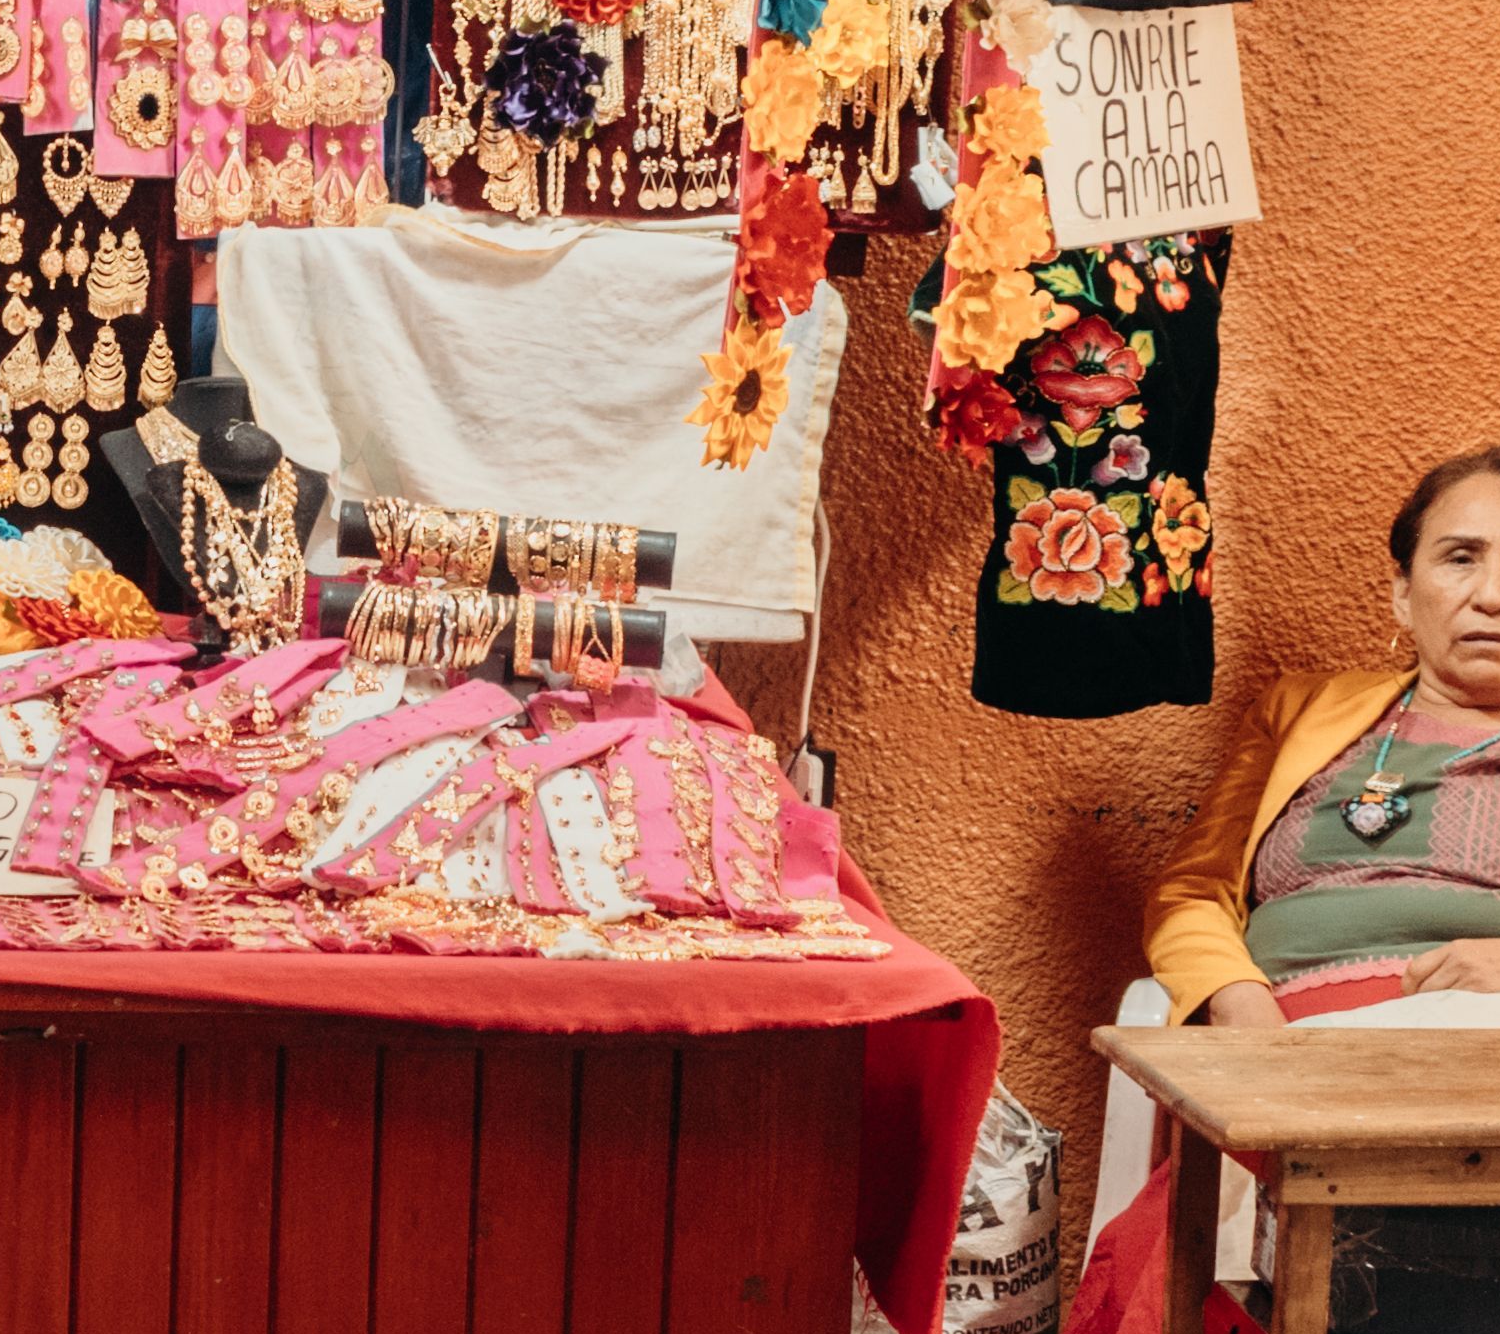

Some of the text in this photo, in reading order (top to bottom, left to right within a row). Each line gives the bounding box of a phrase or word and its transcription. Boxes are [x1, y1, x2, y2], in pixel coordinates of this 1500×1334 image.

[1101, 90, 1190, 159] A LA
[1074, 140, 1230, 220] CAMARA
[945, 1235, 1048, 1277] LIMENTO
